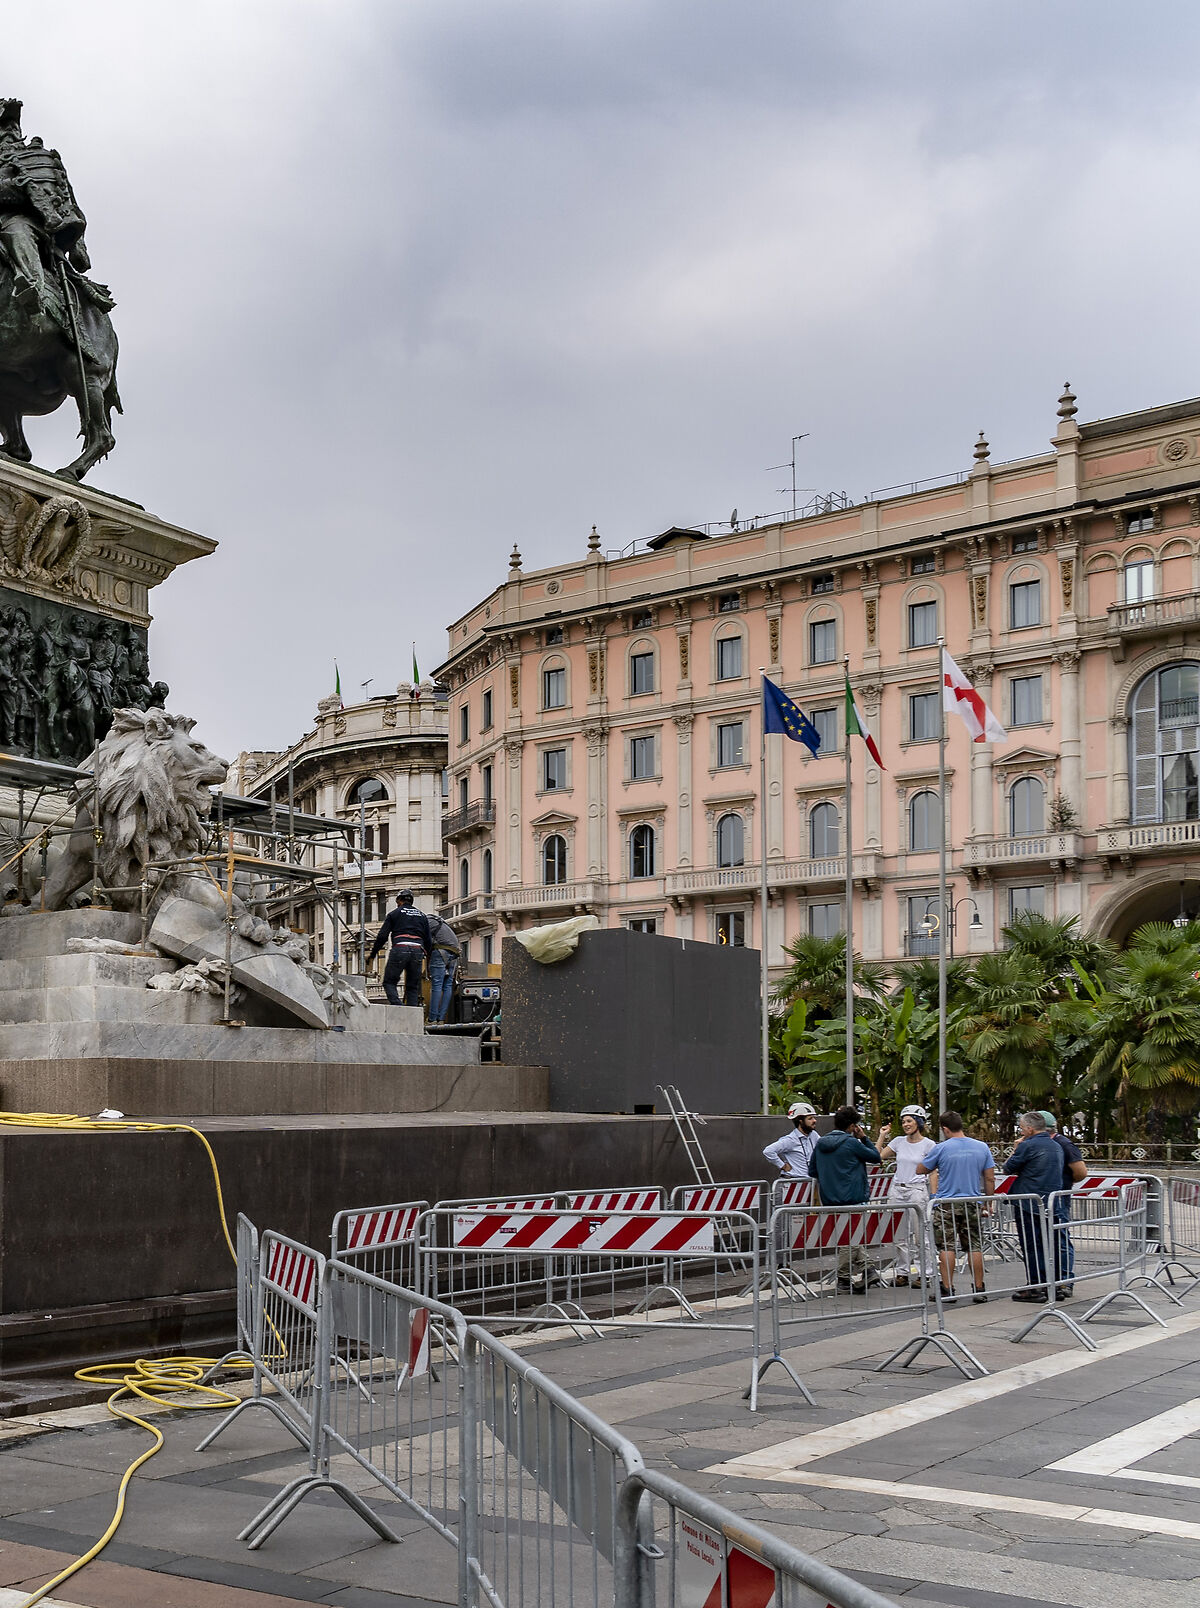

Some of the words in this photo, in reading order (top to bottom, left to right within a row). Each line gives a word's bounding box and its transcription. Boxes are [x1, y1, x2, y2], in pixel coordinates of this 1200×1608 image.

[682, 1520, 698, 1539] Comune
[705, 1534, 720, 1552] Milano
[701, 1549, 715, 1566] Locale
